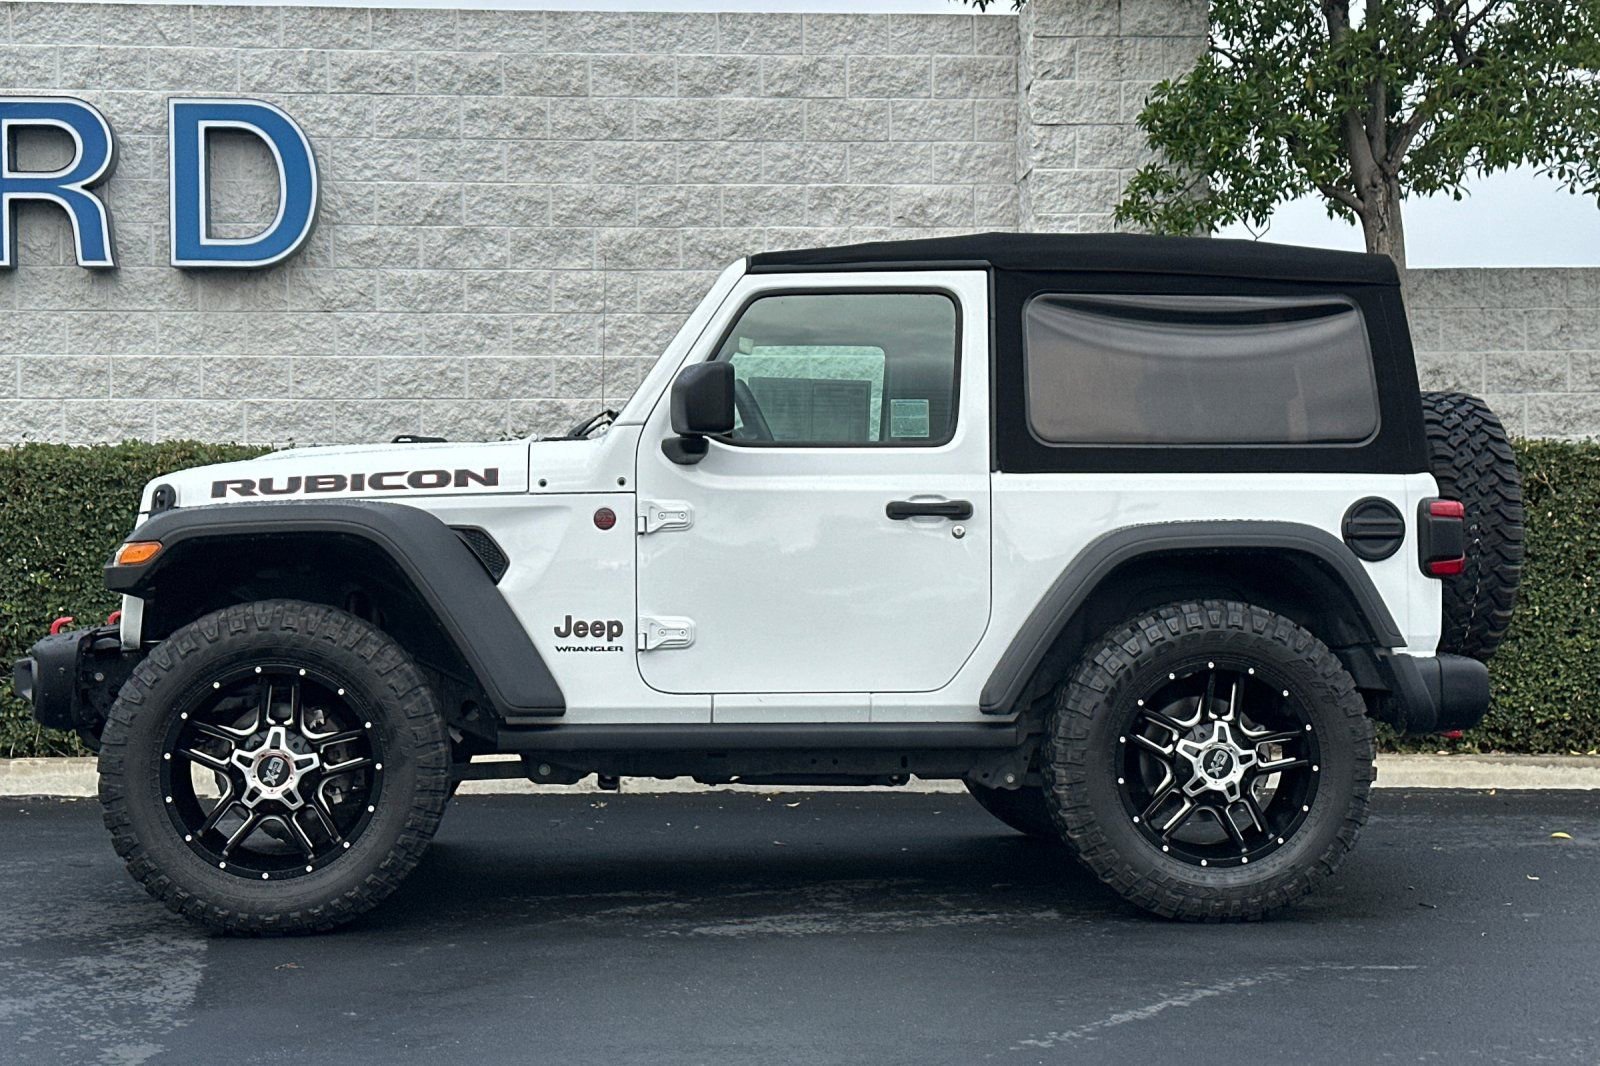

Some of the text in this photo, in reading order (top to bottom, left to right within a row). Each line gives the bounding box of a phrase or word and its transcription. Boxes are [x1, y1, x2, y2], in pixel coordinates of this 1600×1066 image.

[0, 96, 319, 268] RD
[211, 467, 499, 498] RUBICON
[553, 614, 624, 642] Jeep
